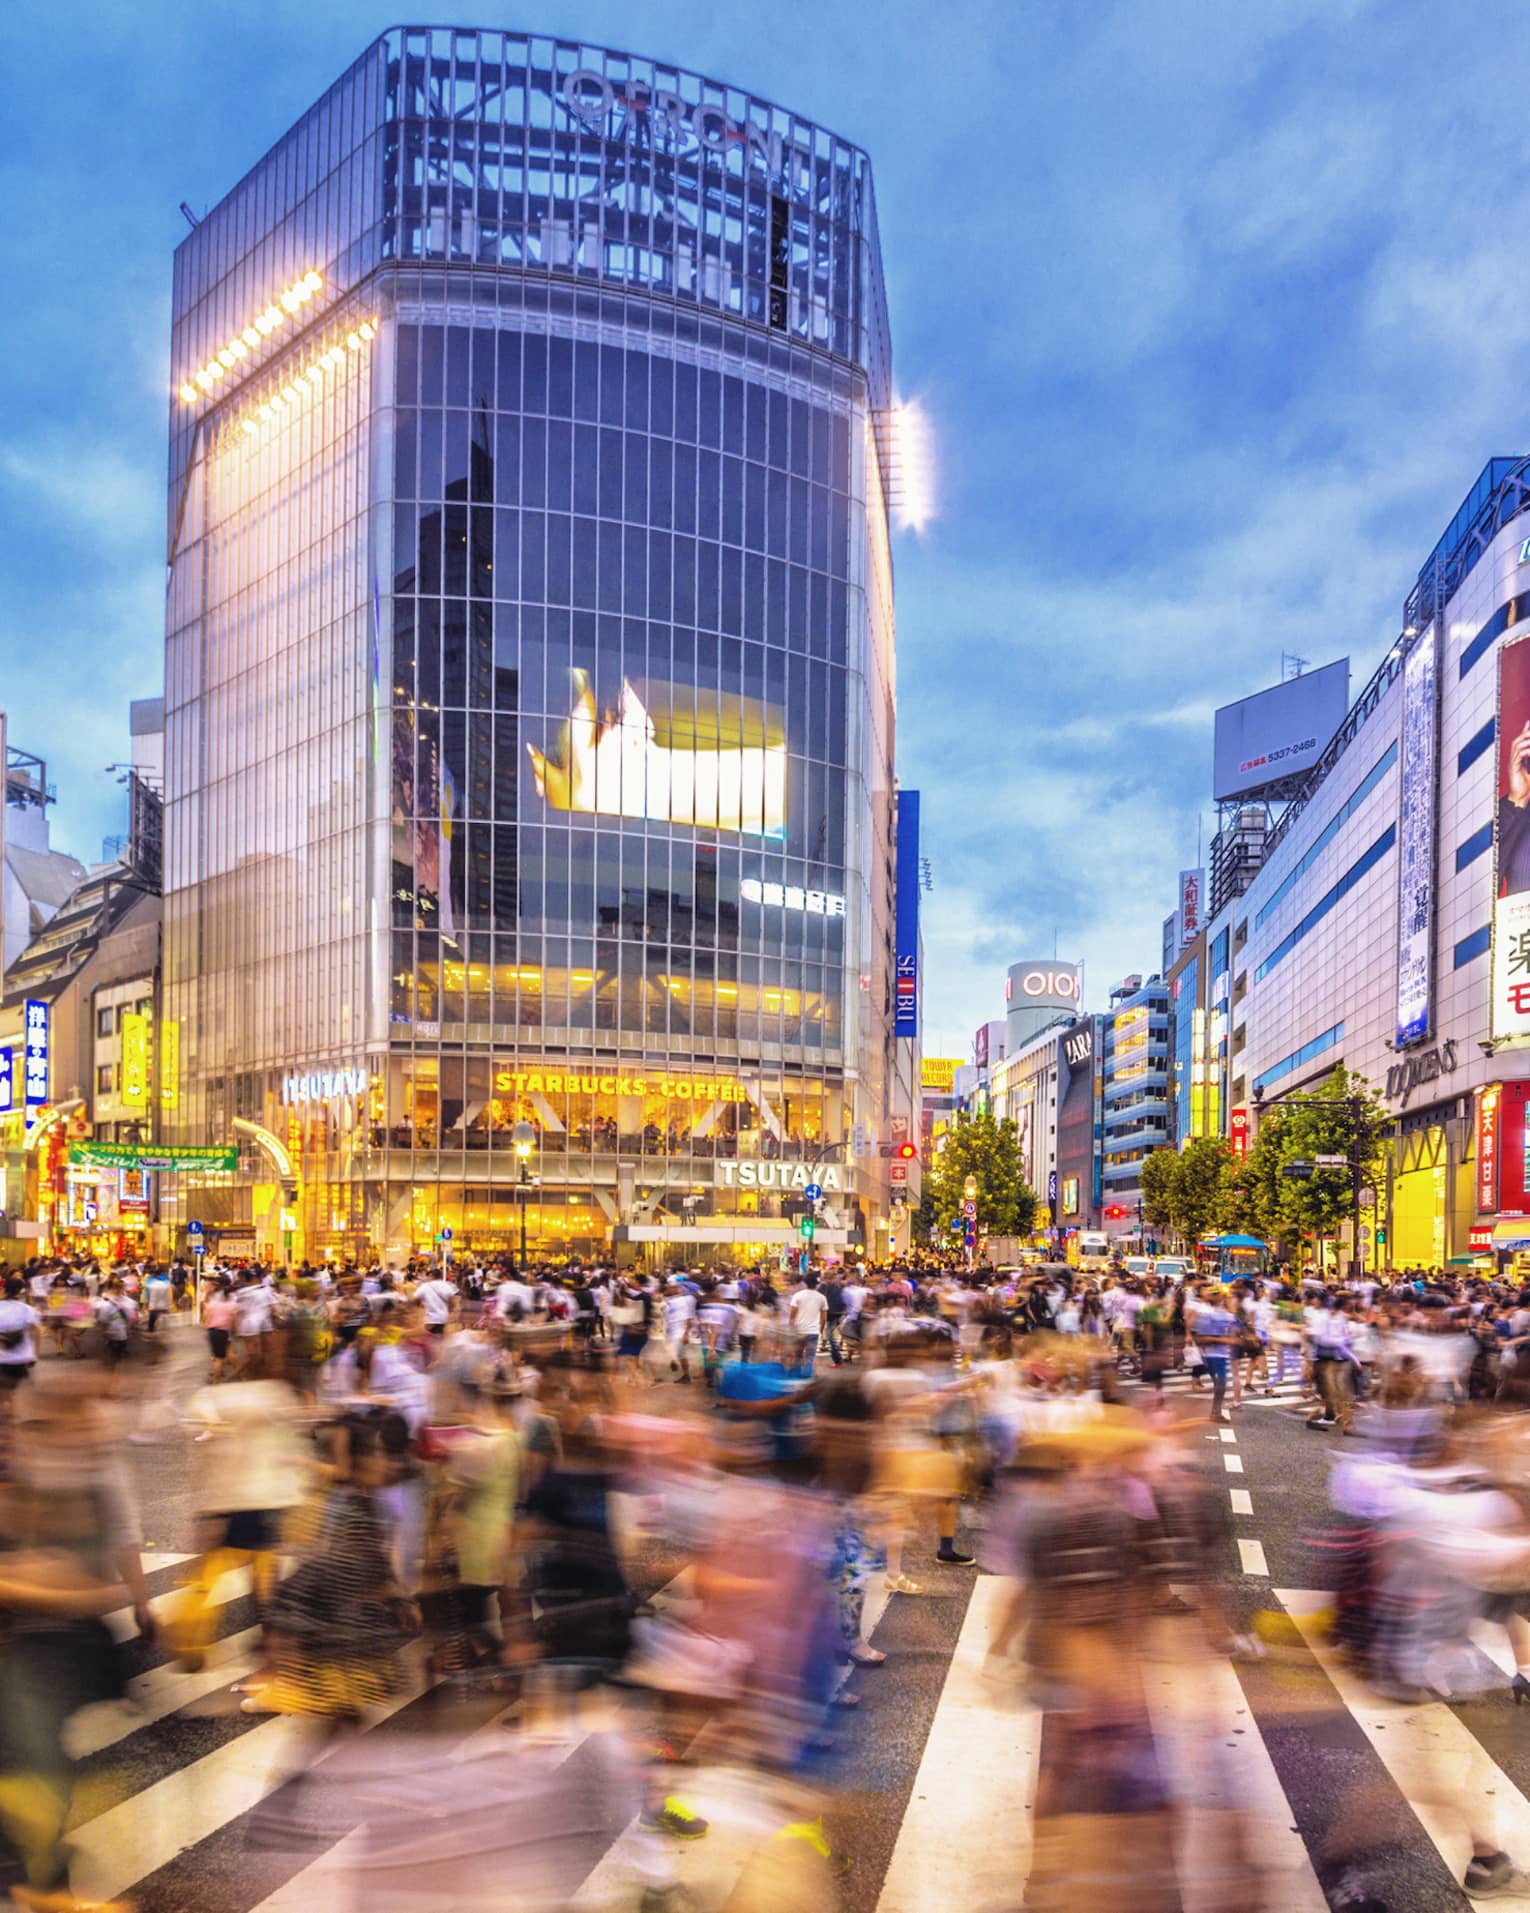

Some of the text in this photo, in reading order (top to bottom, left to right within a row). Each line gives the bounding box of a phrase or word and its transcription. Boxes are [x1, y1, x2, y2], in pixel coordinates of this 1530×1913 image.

[1268, 738, 1317, 763] 5337-2468
[1184, 876, 1198, 931] 大和証券
[897, 955, 915, 1020] SEIBU
[496, 1072, 746, 1103] STARBUCKS COFFEE
[719, 1161, 840, 1189] TSUTAYA
